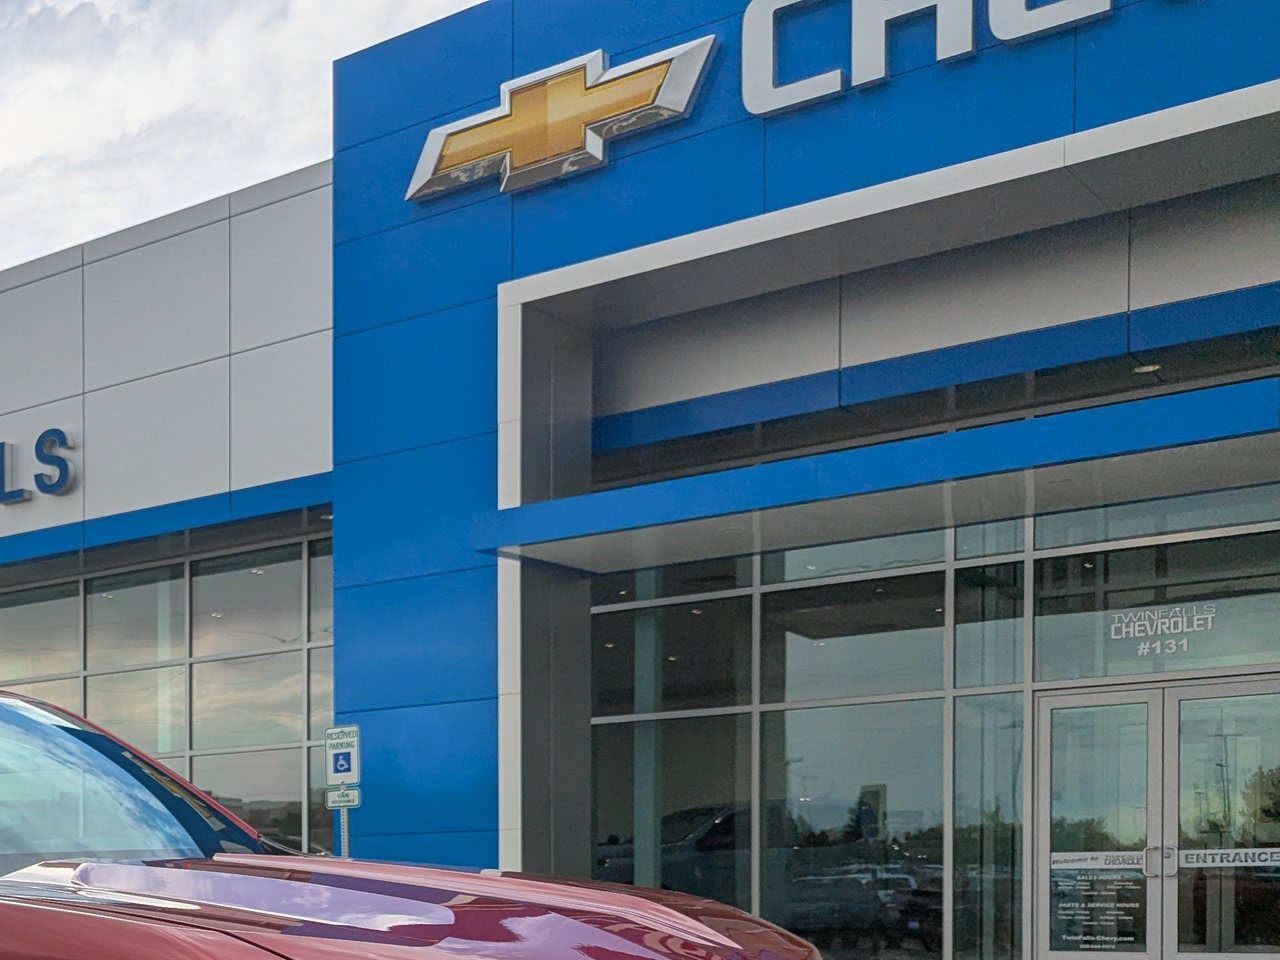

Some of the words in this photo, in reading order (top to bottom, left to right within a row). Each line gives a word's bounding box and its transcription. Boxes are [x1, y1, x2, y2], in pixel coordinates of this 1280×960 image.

[1111, 614, 1216, 639] CHEVROLET
[1138, 638, 1188, 656] #131
[327, 731, 357, 740] RESERVED
[329, 741, 355, 750] PARKING
[1184, 852, 1280, 864] ENTRANCE
